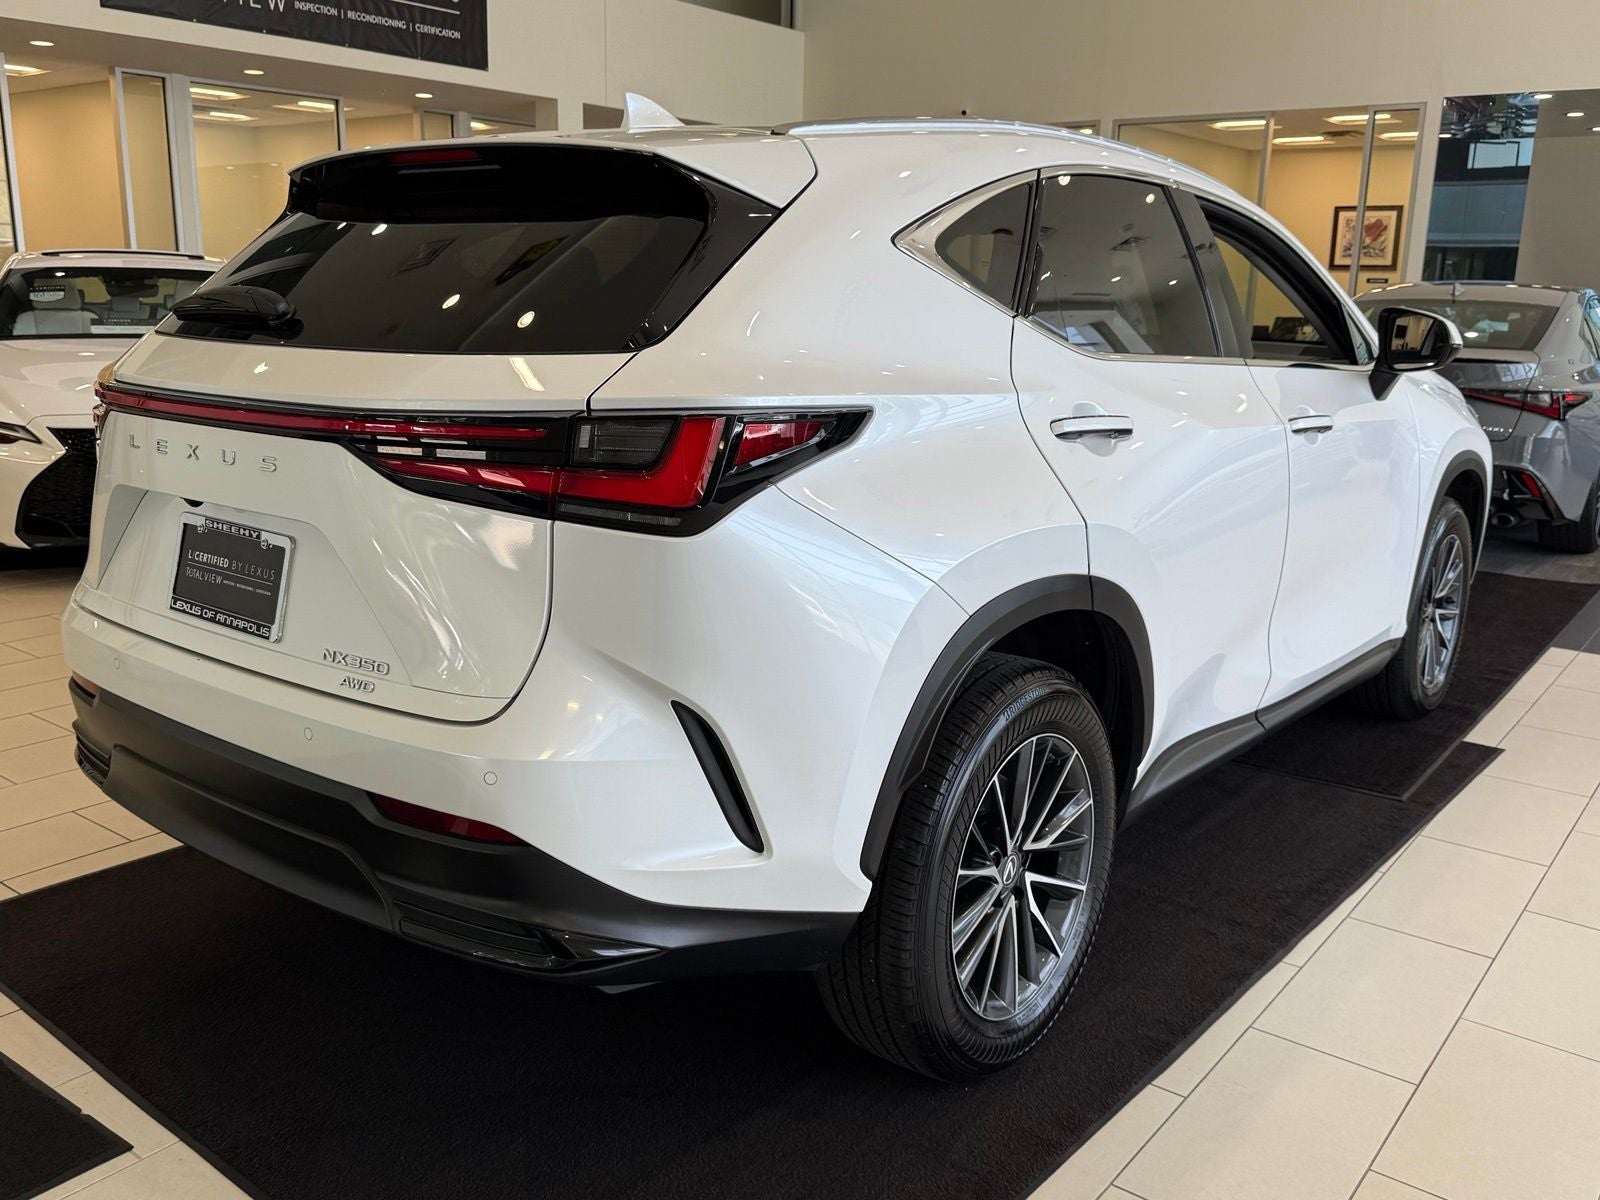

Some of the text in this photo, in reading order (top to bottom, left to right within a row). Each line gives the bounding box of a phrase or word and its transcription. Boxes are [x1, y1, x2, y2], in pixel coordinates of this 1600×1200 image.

[294, 1, 338, 16] INSPECTION
[347, 10, 407, 30] RECONDITIONING
[415, 24, 461, 39] CERTIFICATION
[128, 434, 278, 473] LEXUS
[205, 519, 260, 540] SHEEHY
[231, 560, 243, 572] BY
[245, 564, 276, 580] LEXUS
[171, 599, 270, 637] LEXUS OF ANNAPOLIS
[323, 647, 391, 676] NX350
[339, 675, 376, 693] AWD
